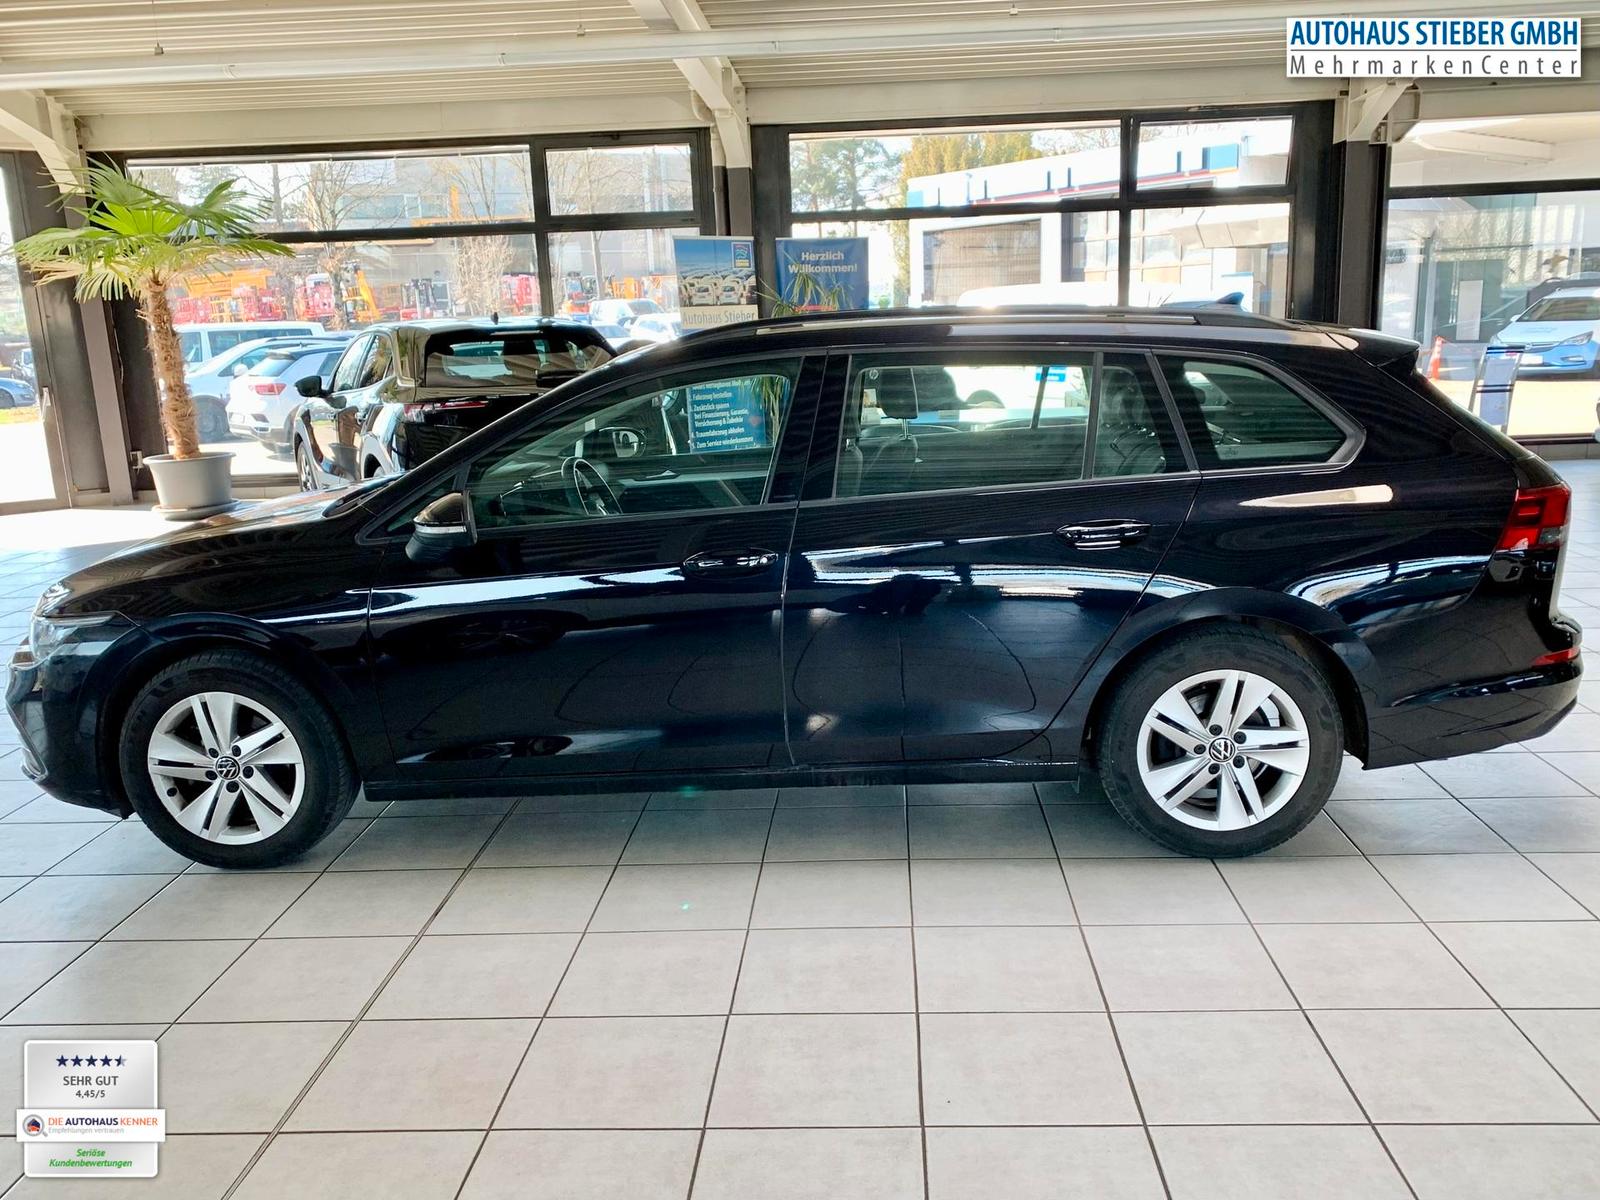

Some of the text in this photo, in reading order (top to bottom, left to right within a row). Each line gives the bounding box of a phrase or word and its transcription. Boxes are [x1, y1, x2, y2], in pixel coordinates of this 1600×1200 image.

[801, 250, 845, 261] Herzlich
[788, 263, 858, 274] Willkommen!
[683, 310, 755, 325] Autohaus Stieber
